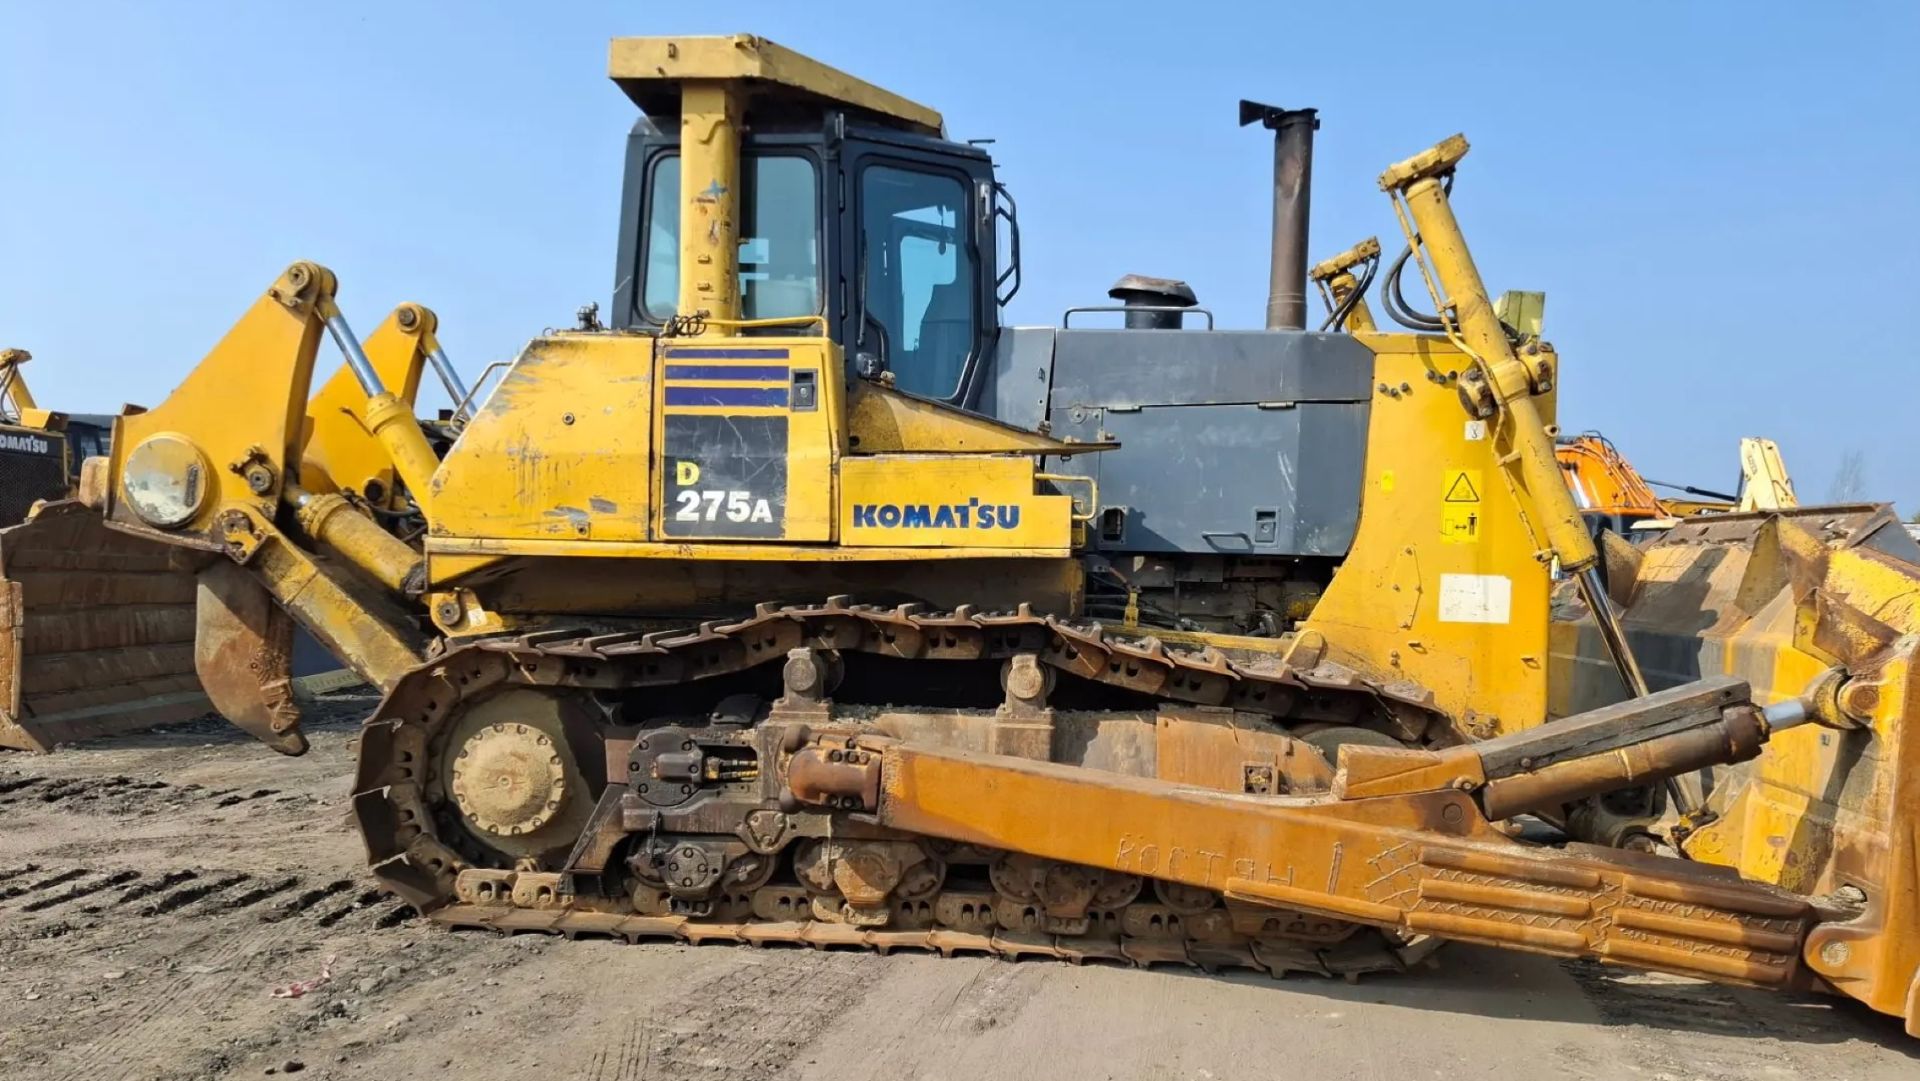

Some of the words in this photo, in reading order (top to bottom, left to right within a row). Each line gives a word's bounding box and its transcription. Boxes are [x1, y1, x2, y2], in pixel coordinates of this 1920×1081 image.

[676, 461, 700, 486] D
[675, 489, 774, 523] 275A
[853, 497, 1019, 529] KOMATSU
